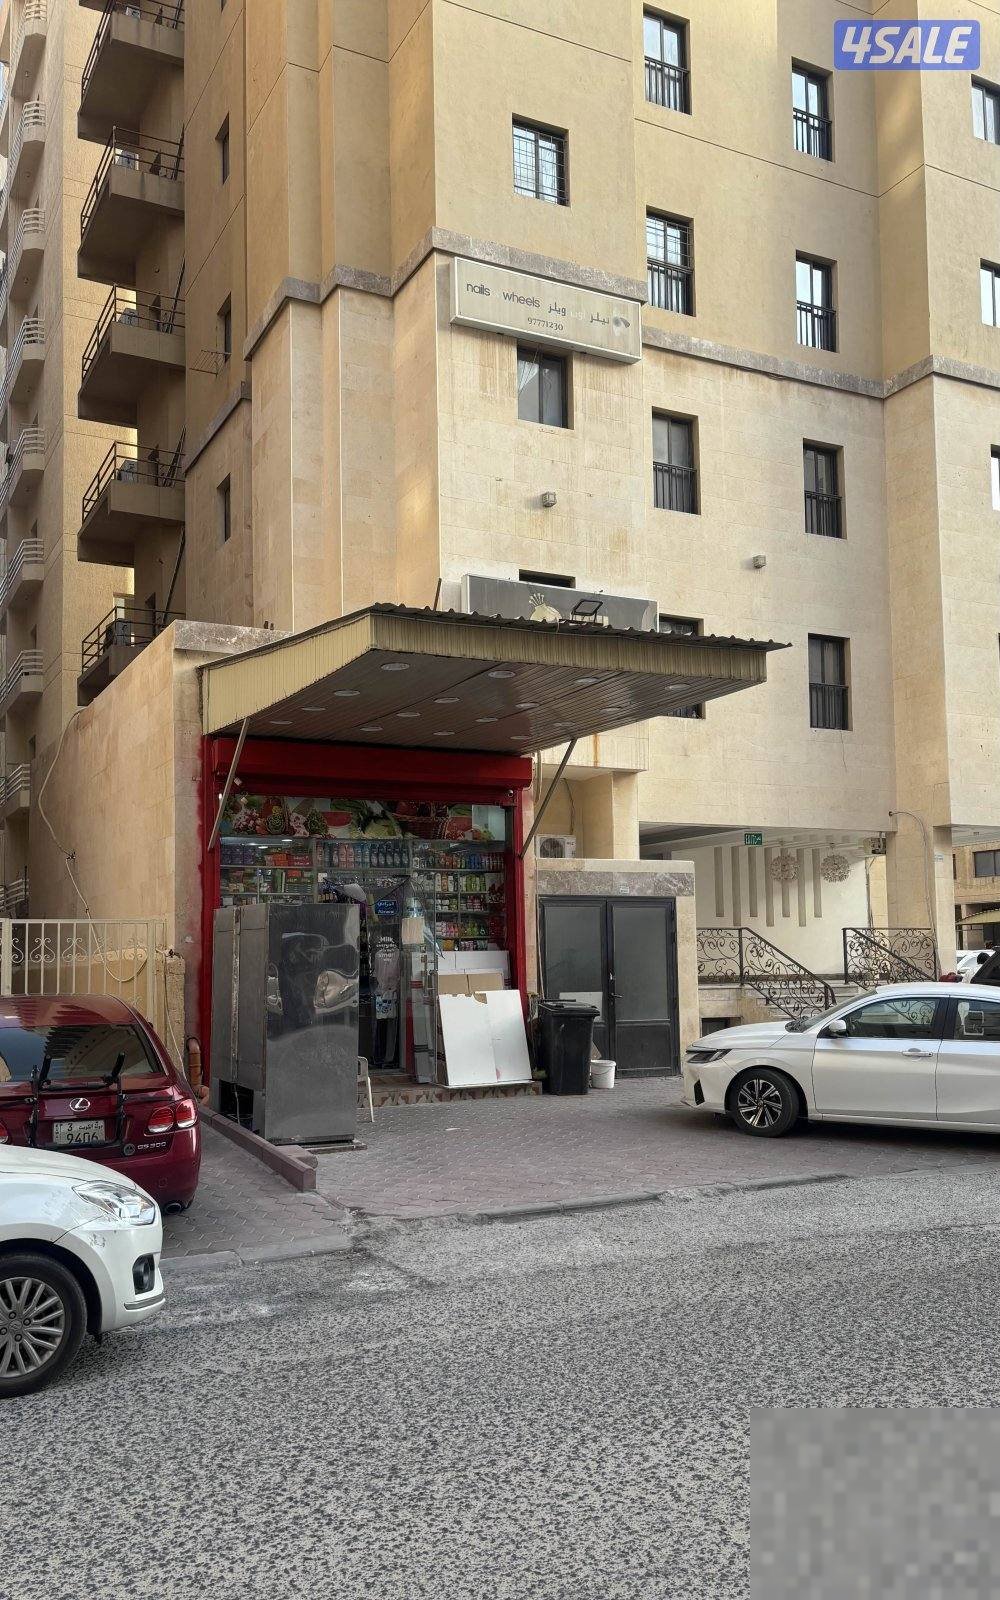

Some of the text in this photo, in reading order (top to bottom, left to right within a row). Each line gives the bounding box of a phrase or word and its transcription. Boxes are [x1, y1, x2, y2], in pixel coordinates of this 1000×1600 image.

[466, 283, 541, 308] nails wheels
[527, 317, 564, 331] 97771230
[67, 1122, 73, 1132] 3
[66, 1132, 99, 1145] 9406
